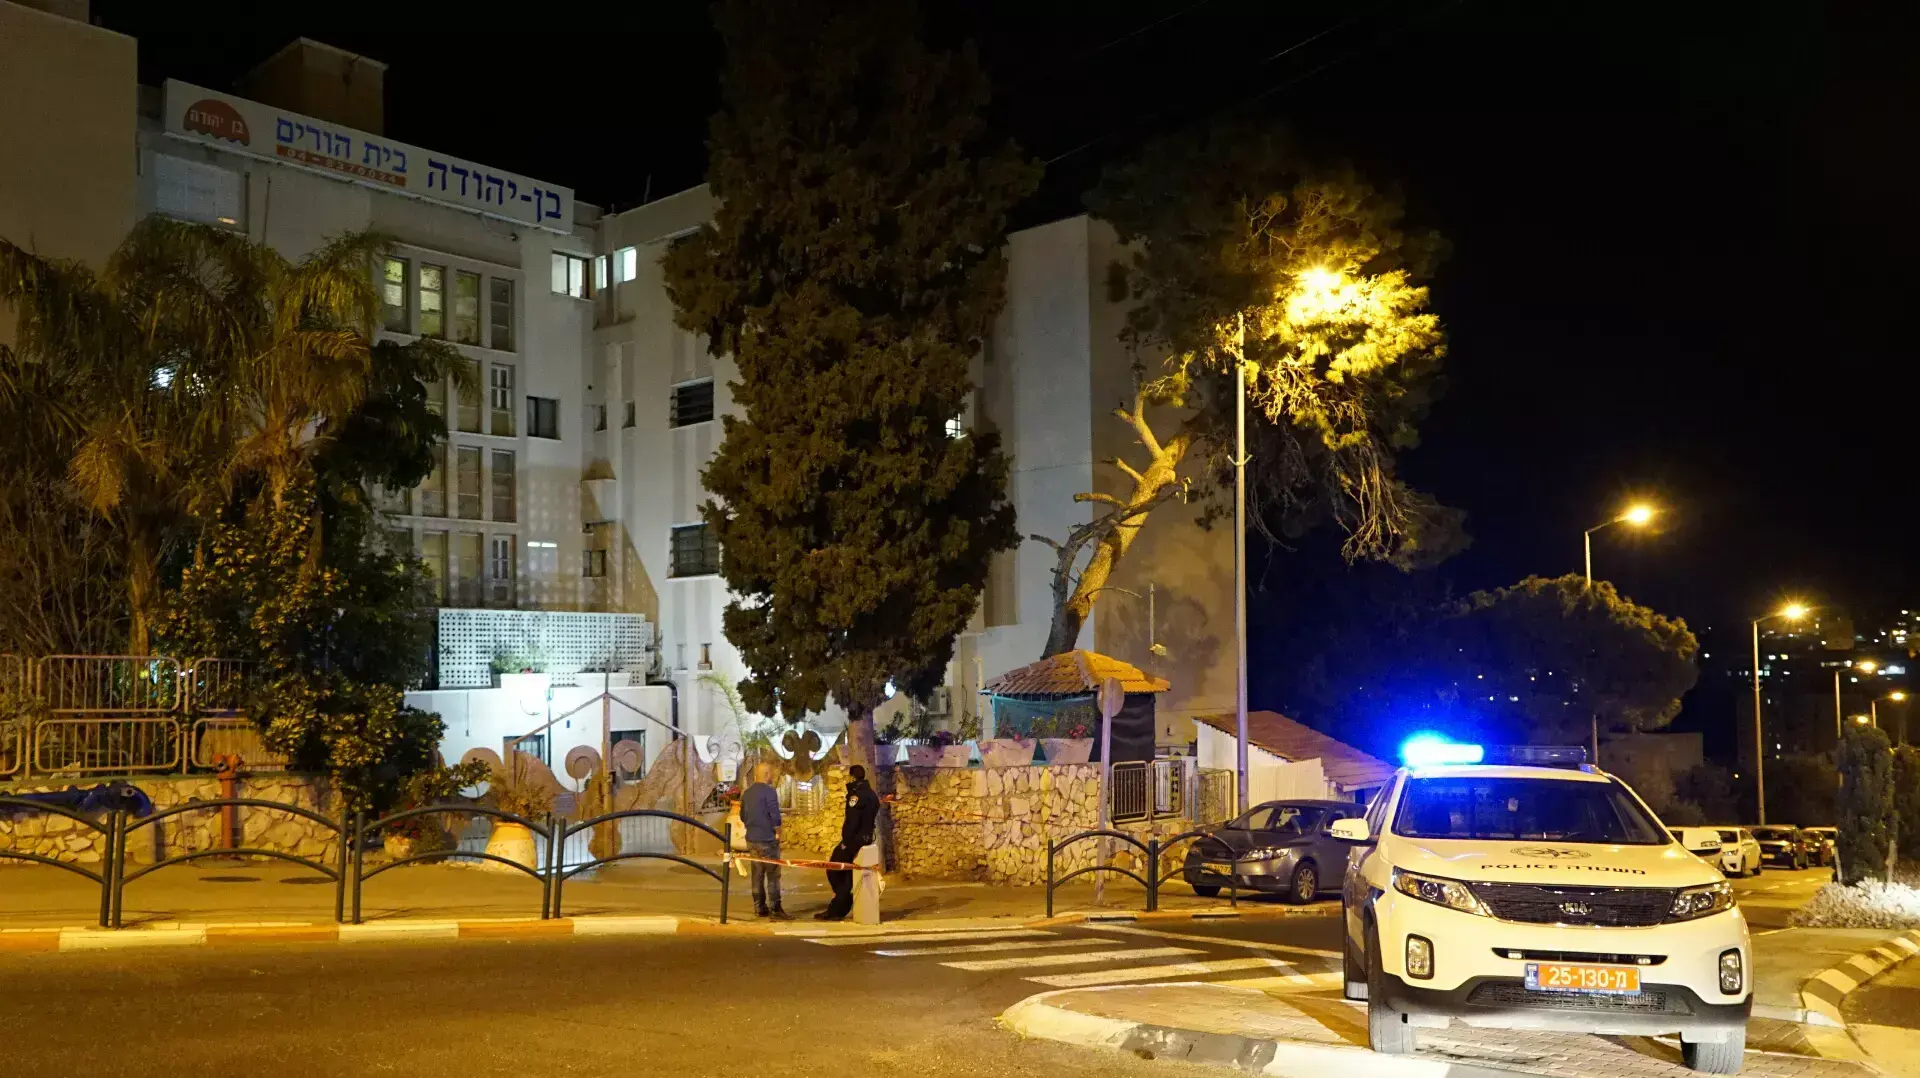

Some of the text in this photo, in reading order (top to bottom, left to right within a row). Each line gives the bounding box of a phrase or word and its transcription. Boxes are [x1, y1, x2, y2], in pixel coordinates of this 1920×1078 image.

[189, 109, 244, 135] בן יהודה
[275, 116, 408, 174] בית הורים
[427, 157, 562, 223] בן-יהודה
[1566, 864, 1646, 875] משטרה
[1564, 902, 1588, 913] KIA
